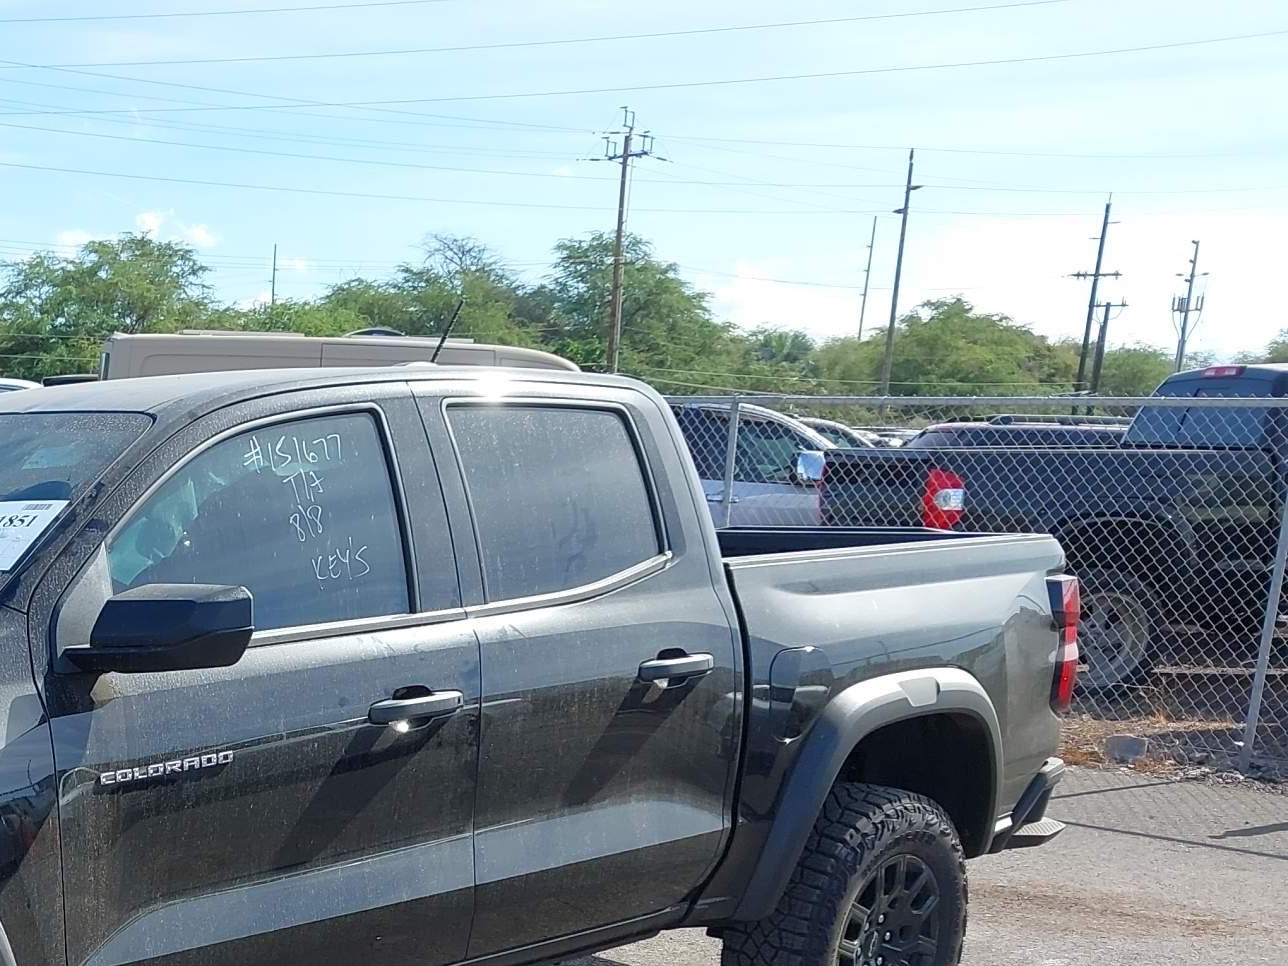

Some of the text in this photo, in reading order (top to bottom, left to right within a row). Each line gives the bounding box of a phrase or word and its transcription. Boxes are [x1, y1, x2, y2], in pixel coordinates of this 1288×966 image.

[243, 434, 342, 473] #151677
[289, 505, 324, 542] 8/8
[312, 537, 371, 581] KEYS
[100, 750, 234, 785] COLORADO
